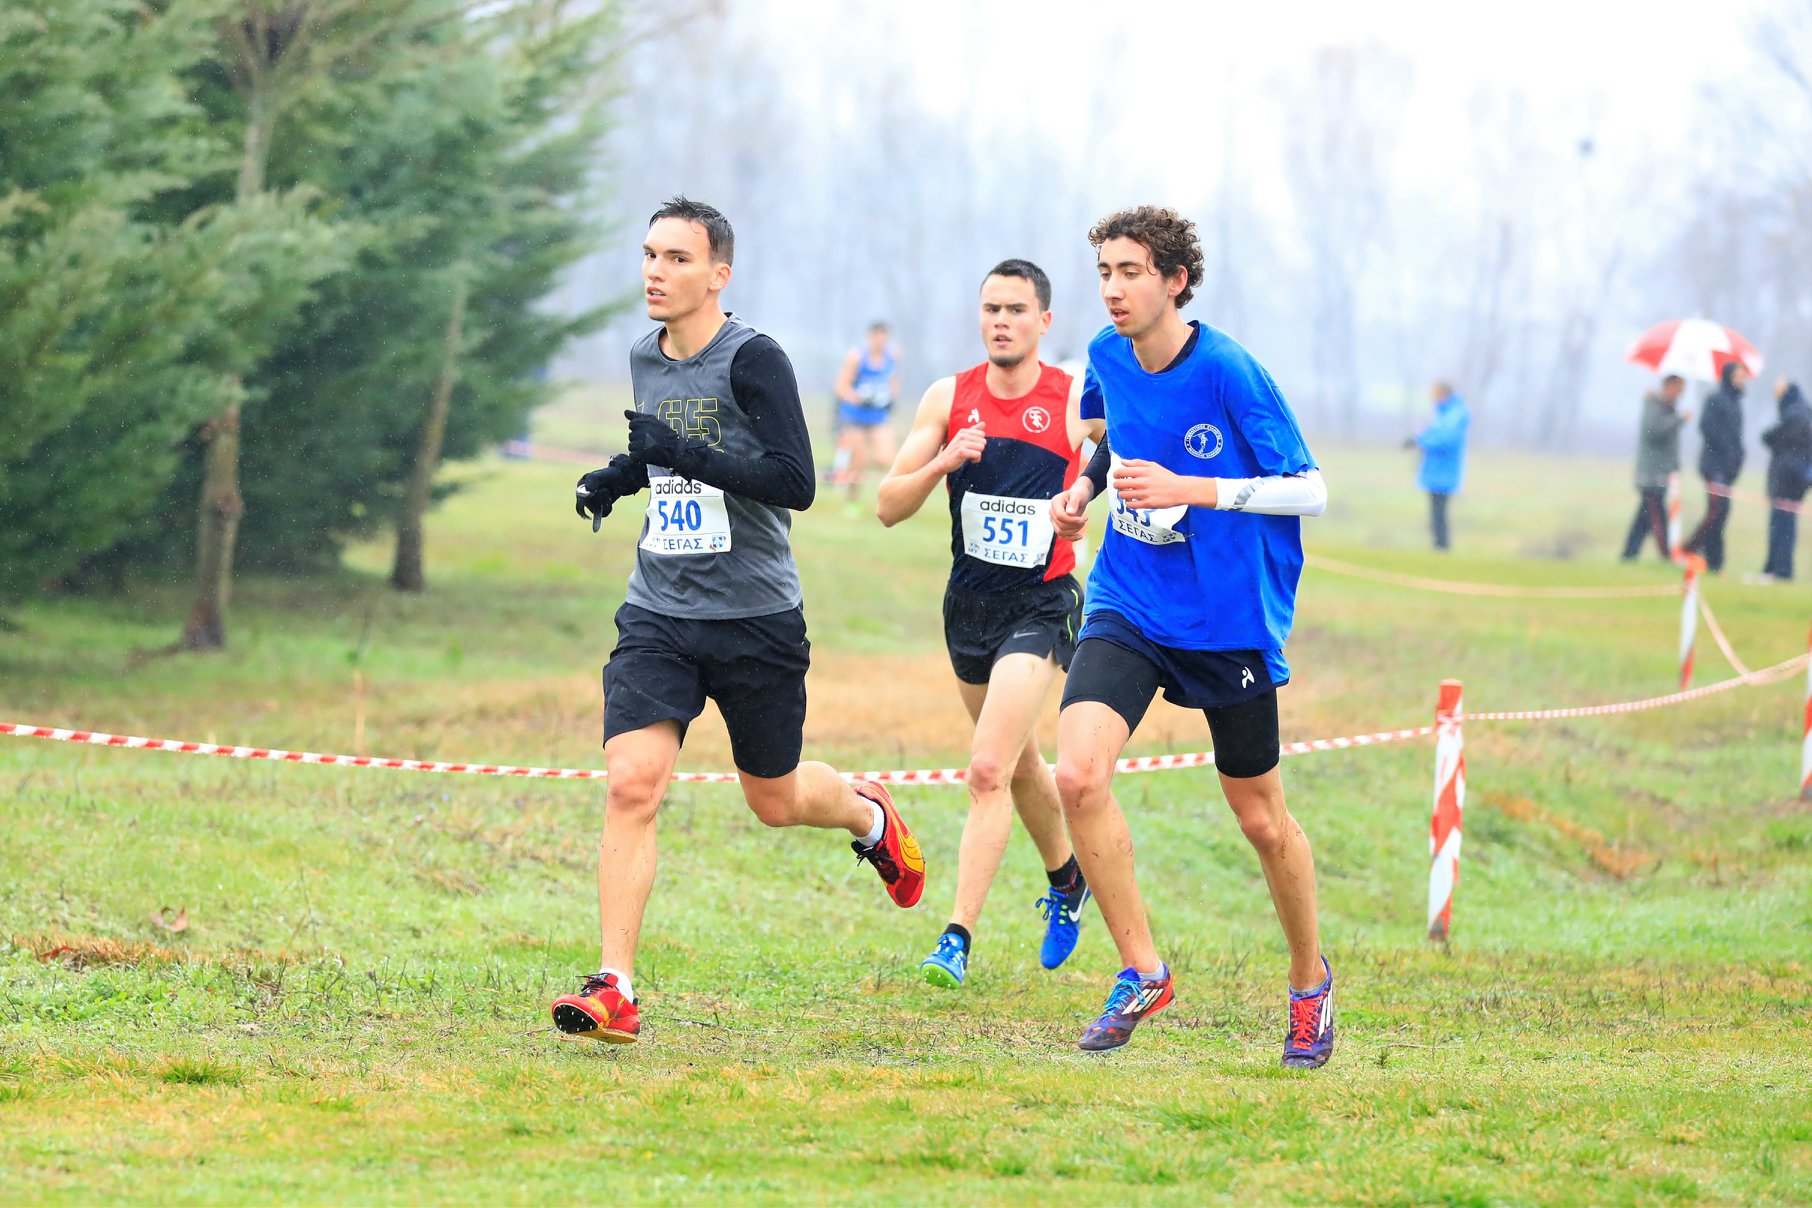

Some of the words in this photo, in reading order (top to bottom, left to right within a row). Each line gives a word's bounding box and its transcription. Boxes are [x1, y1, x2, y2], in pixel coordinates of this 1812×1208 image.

[655, 479, 702, 494] adidas
[980, 499, 1036, 515] adidas
[658, 500, 702, 531] 540
[982, 516, 1028, 547] 551
[1118, 519, 1158, 543] ΣΕΓΑΣ
[663, 538, 704, 550] ΣΕΓΑΣ
[984, 548, 1029, 563] ΣΕΓΑΣ
